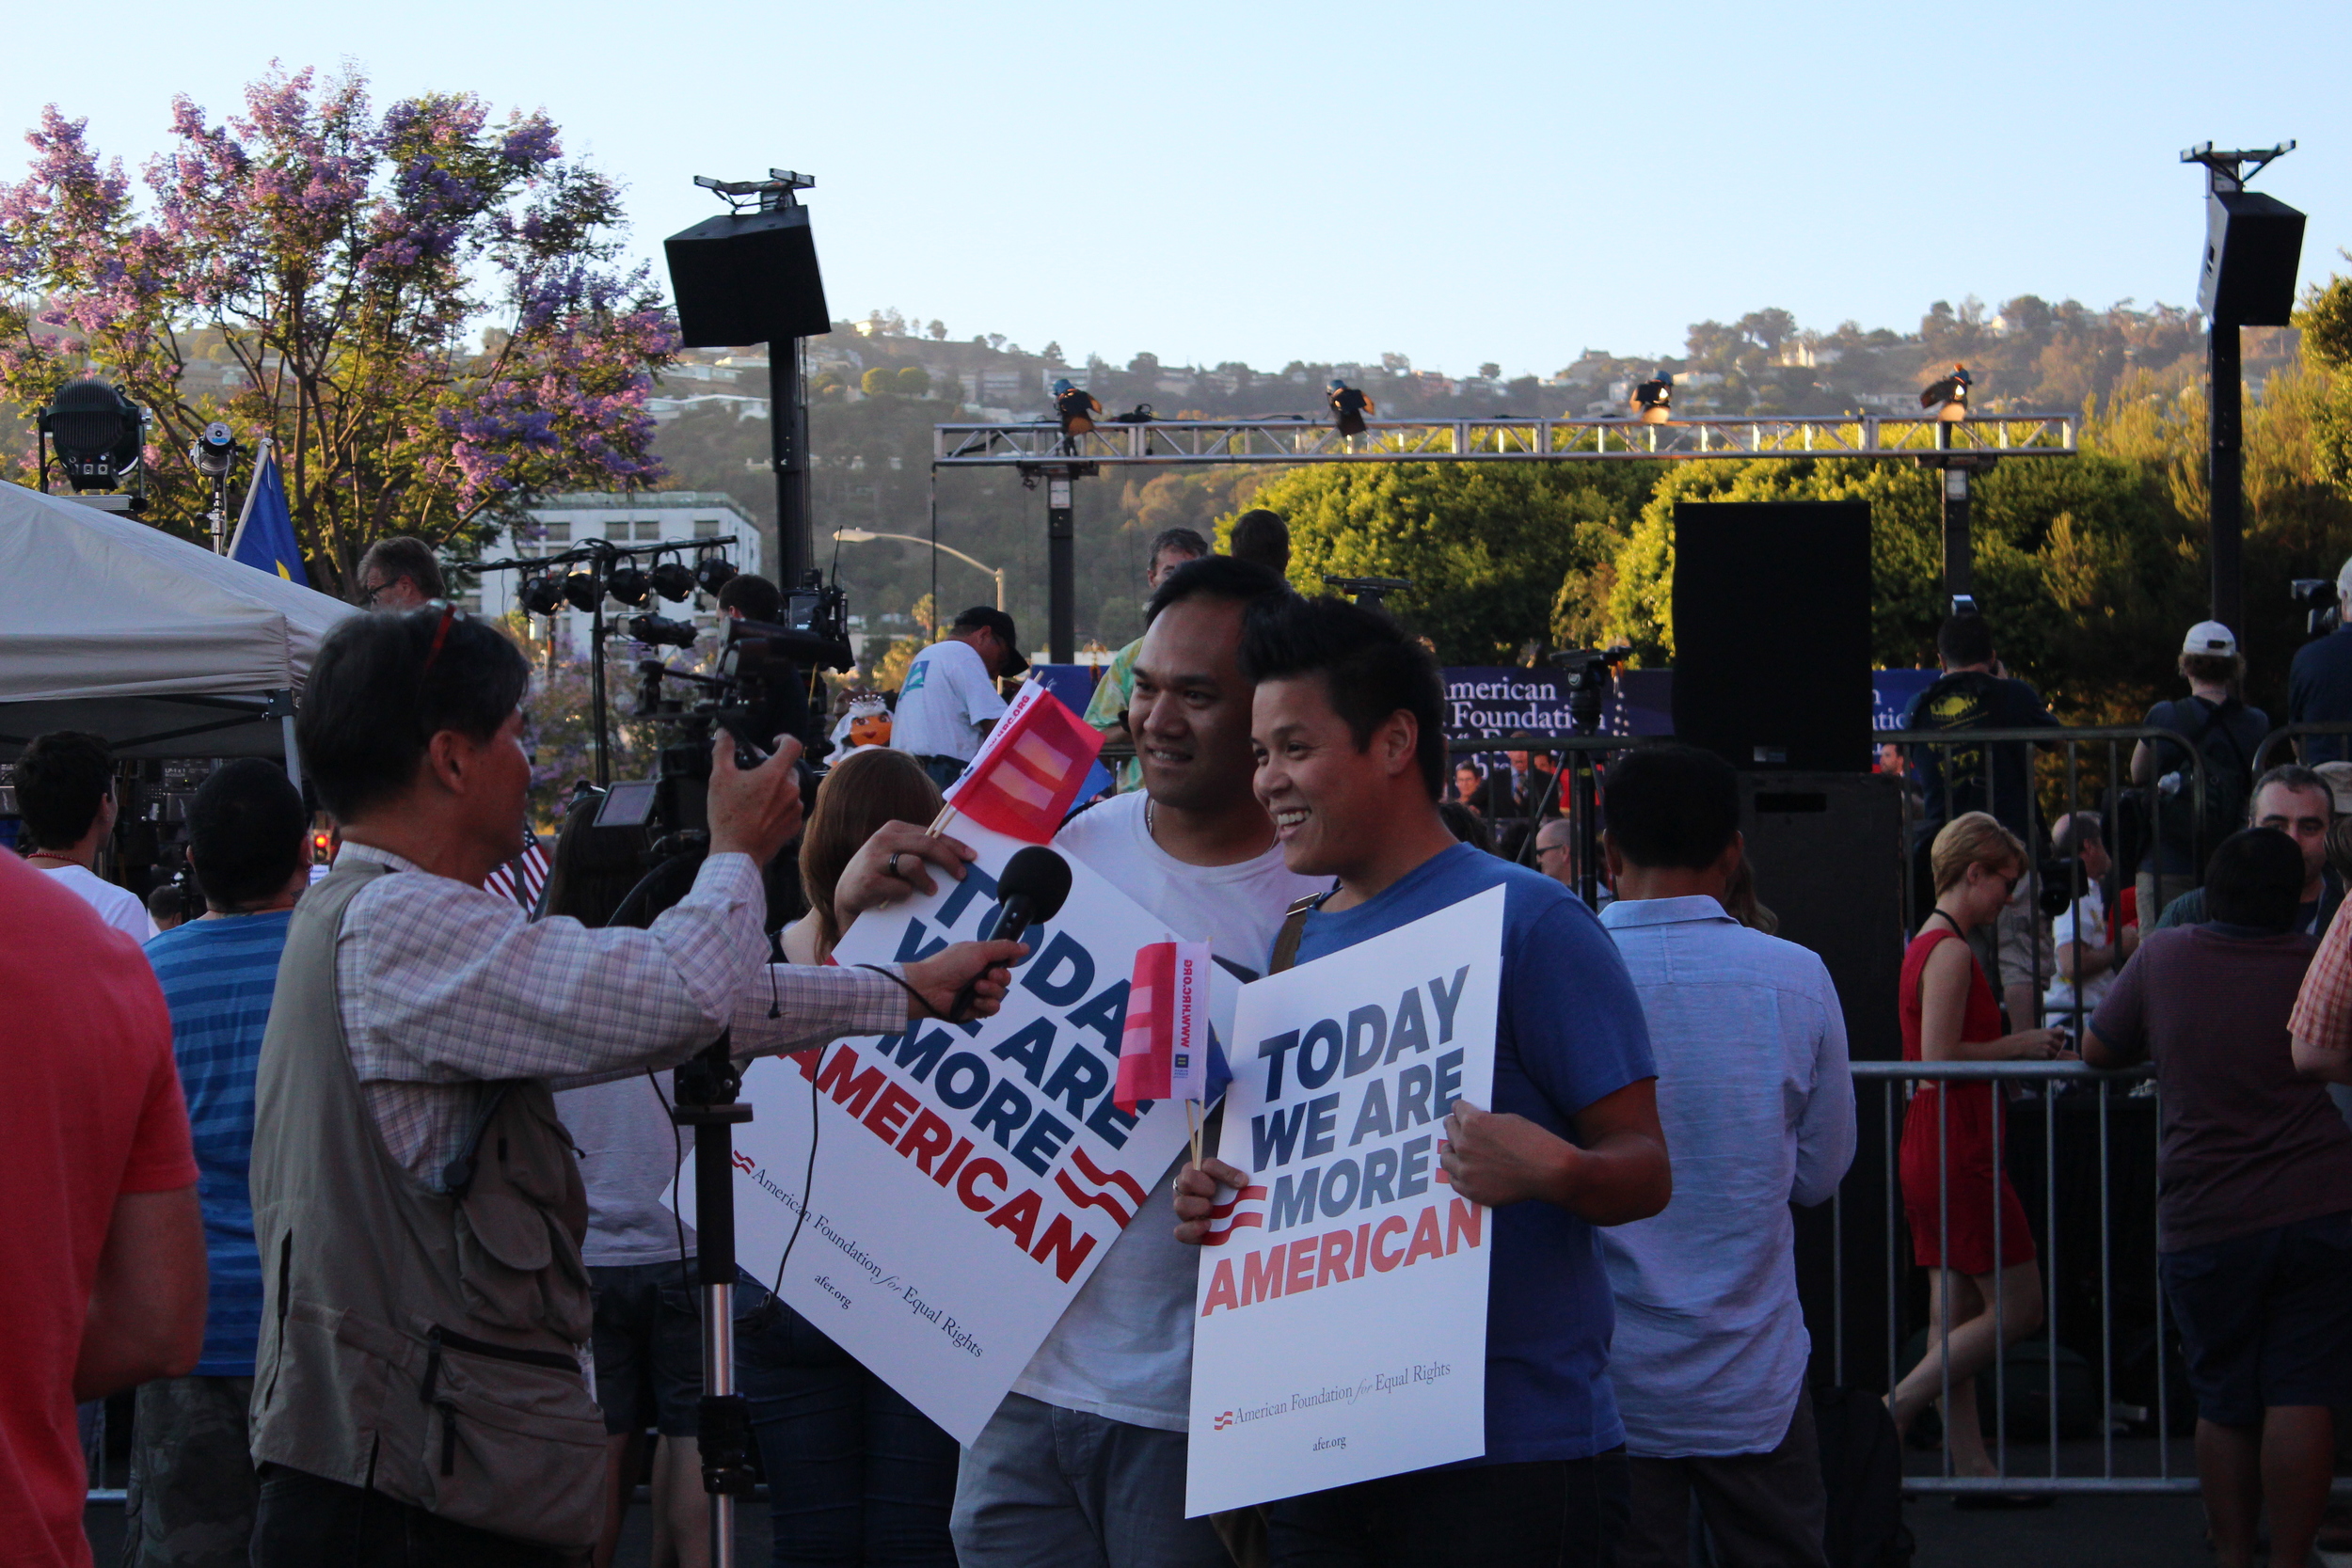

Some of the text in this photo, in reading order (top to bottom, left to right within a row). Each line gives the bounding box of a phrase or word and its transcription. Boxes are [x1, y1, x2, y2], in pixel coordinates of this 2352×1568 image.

[1443, 676, 1557, 702] merican
[1451, 701, 1607, 730] Foundati
[933, 862, 1133, 1060] TODA
[990, 1015, 1156, 1151] ARE
[1257, 964, 1470, 1103] TODAY
[875, 1017, 1075, 1178] MORE
[1250, 1047, 1465, 1174] WE ARE
[1268, 1133, 1432, 1233] MORE
[752, 1168, 983, 1357] American Foundation for Equal Rights
[814, 1274, 852, 1310] afer.org
[1200, 1196, 1483, 1318] AMERICAN
[1233, 1361, 1452, 1424] American Foundation for Equal Rights
[1312, 1435, 1347, 1452] afer.org
